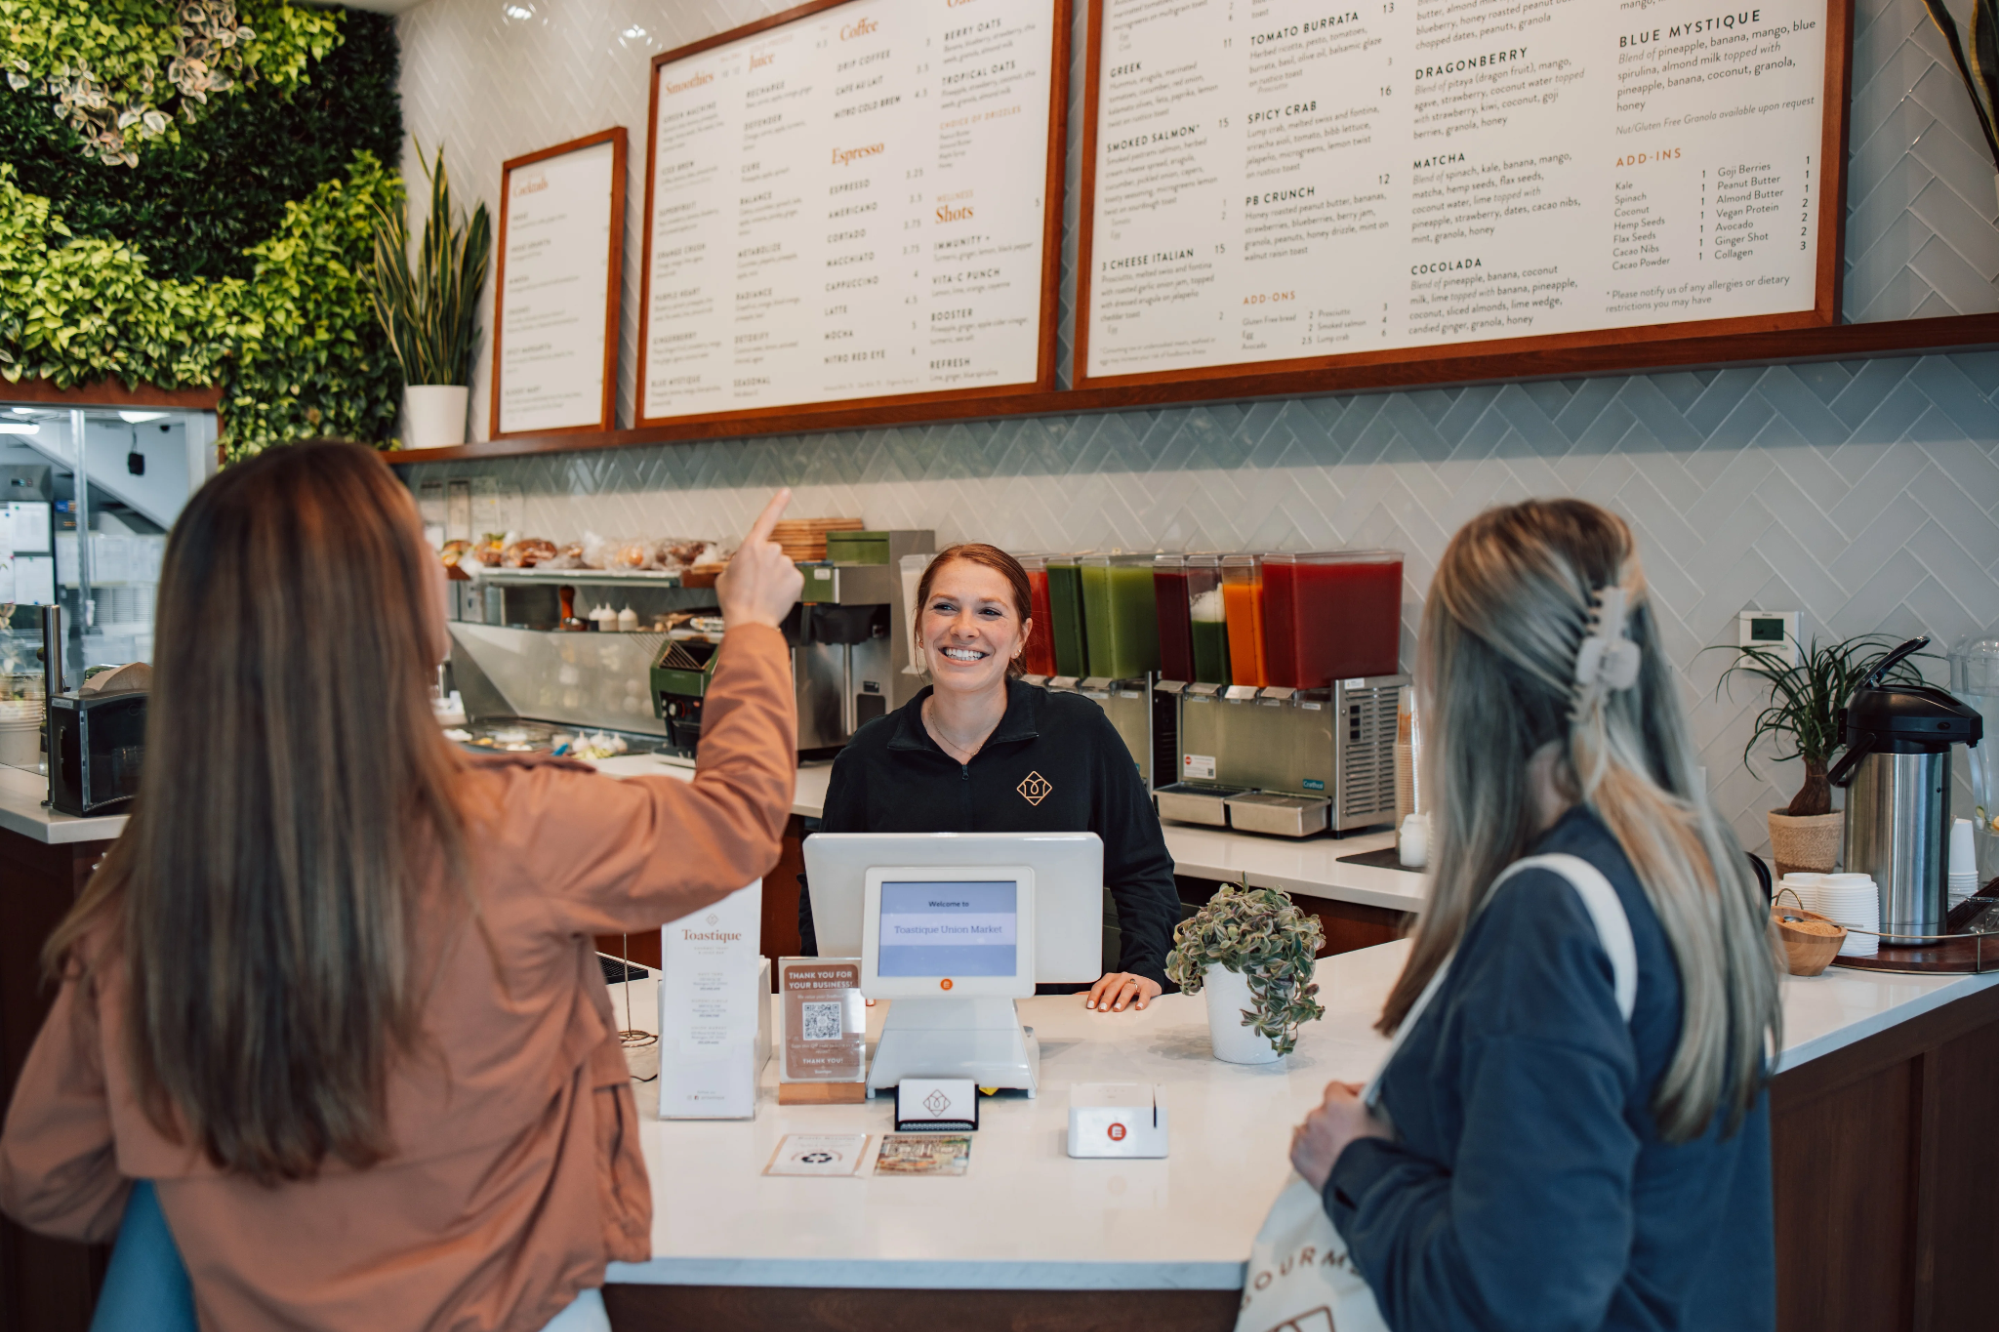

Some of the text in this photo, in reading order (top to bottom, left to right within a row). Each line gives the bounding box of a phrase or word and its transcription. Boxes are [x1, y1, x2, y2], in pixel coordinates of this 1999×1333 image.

[1384, 3, 1394, 13] 13
[840, 18, 878, 41] Coffee
[945, 19, 1001, 41] BERRY OATS
[1251, 12, 1358, 45] TOMATO BURRATA
[1620, 10, 1760, 48] BLUE MYSTIQUE
[1224, 39, 1232, 48] 11
[1619, 21, 1816, 64] Blend of pineapple, banana, mango, blue
[837, 50, 890, 72] DRIP COFFEE
[1416, 48, 1527, 80] DRAGONBERRY
[1618, 41, 1781, 82] spirulina, almond milk topped with
[942, 61, 1015, 84] TROPICAL OATS
[1111, 62, 1141, 77] GREEK
[855, 82, 865, 90] AU
[868, 75, 883, 87] LAIT
[1617, 59, 1796, 99] pineapple, banana, coconut, granola,
[1380, 86, 1391, 96] 16
[834, 96, 901, 118] NITRO COLD BREW
[1248, 101, 1316, 124] SPICY CRAB
[1617, 102, 1646, 112] honey
[1219, 118, 1229, 128] 15
[1616, 97, 1815, 135] Nut/Gluten Free Granola available upon request
[1108, 136, 1148, 152] SMOKED
[832, 143, 884, 166] Espresso
[1414, 153, 1465, 169] MATCHA
[1616, 149, 1681, 167] ADD-INS
[1806, 156, 1810, 164] 1
[1718, 164, 1771, 177] Goji Berries
[1379, 175, 1390, 184] 12
[1615, 181, 1633, 190] Kale
[1718, 177, 1780, 190] Peanut Butter
[829, 179, 870, 196] ESPRESSO
[1246, 187, 1315, 206] PB CRUNCH
[1615, 192, 1647, 206] Spinach
[1717, 190, 1784, 204] Almond Butter
[1802, 199, 1808, 207] 2
[829, 202, 877, 219] AMERICANO
[936, 205, 973, 224] Shots
[1614, 207, 1649, 217] Coconut
[1716, 205, 1779, 218] Vegan Protein
[1802, 213, 1807, 221] 2
[1614, 217, 1665, 230] Hemp Seeds
[1716, 220, 1754, 231] Avocado
[827, 229, 866, 243] CORTADO
[1614, 231, 1656, 243] Flax Seeds
[1801, 227, 1806, 236] 2
[935, 236, 981, 249] IMMUNITY
[1715, 233, 1768, 247] Ginger Shot
[1800, 242, 1806, 250] 3
[1215, 244, 1225, 254] 15
[1613, 245, 1659, 257] Cacao Nibs
[1715, 249, 1753, 261] Collagen
[1111, 255, 1148, 270] CHEESE
[1153, 249, 1193, 262] ITALIAN
[1612, 257, 1670, 270] Cacao Powder
[1411, 259, 1482, 275] COCOLADA
[933, 269, 1000, 284] VITA-C PUNCH
[1411, 266, 1558, 290] Blend of pineapple, banana, coconut
[825, 276, 878, 292] CAPPUCCINO
[1612, 290, 1638, 299] Please
[1640, 286, 1665, 298] notify
[1679, 284, 1688, 293] of
[1690, 285, 1705, 294] any
[1708, 281, 1743, 292] allergies
[1746, 279, 1755, 287] or
[1758, 277, 1790, 286] dietary
[1243, 291, 1295, 305] ADD-ONS
[1606, 296, 1712, 313] restrictions you may have
[825, 305, 847, 316] LATTE
[931, 309, 972, 322] BOOSTER
[825, 331, 853, 340] MOCHA
[824, 350, 885, 364] NITRO RED EYE
[930, 358, 970, 369] REFRESH
[681, 929, 741, 943] Toastique
[895, 925, 938, 935] Toastique
[941, 925, 968, 933] Union
[971, 925, 1002, 933] Market
